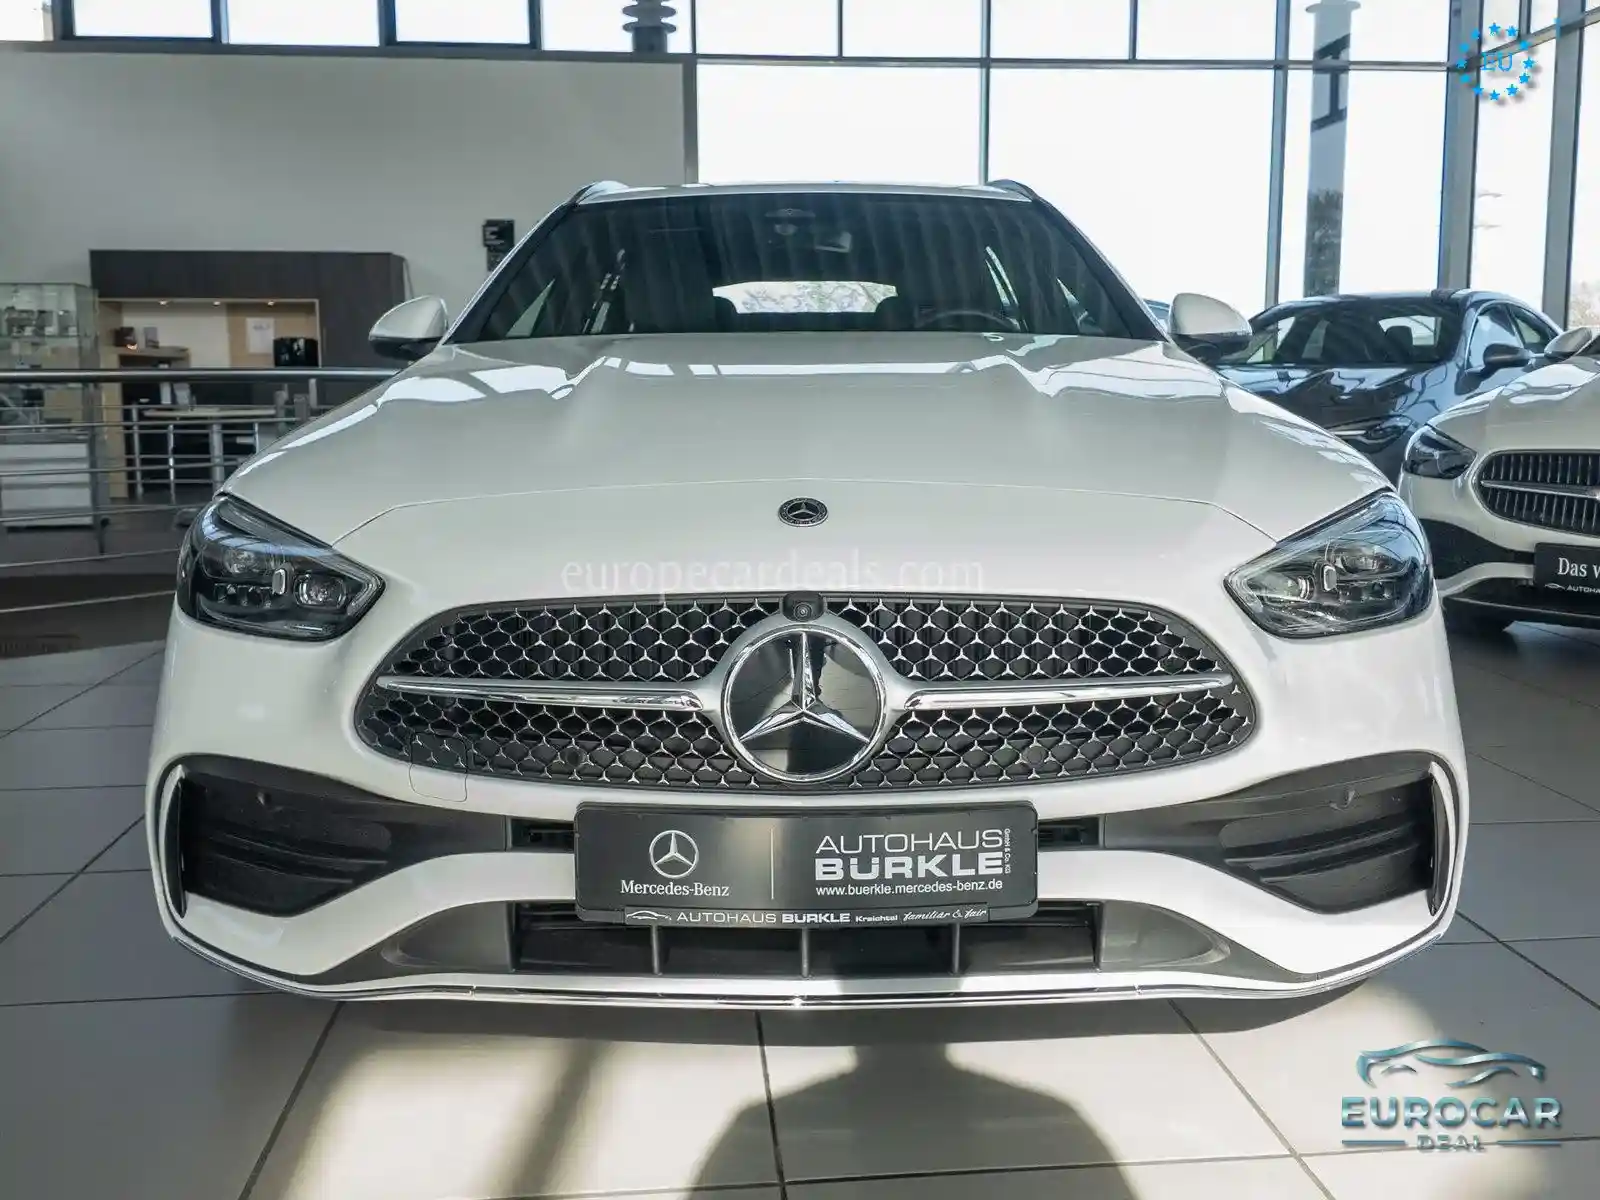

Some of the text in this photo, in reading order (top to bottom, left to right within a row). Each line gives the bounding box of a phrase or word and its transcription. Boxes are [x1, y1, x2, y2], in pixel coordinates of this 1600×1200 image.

[1557, 557, 1588, 577] Das
[815, 828, 1003, 854] AUTOHAUS
[620, 879, 730, 897] Mercedes-Benz
[815, 878, 1003, 896] www.buerkle.mercedes-benz.de
[676, 911, 777, 923] AUTOHAUS
